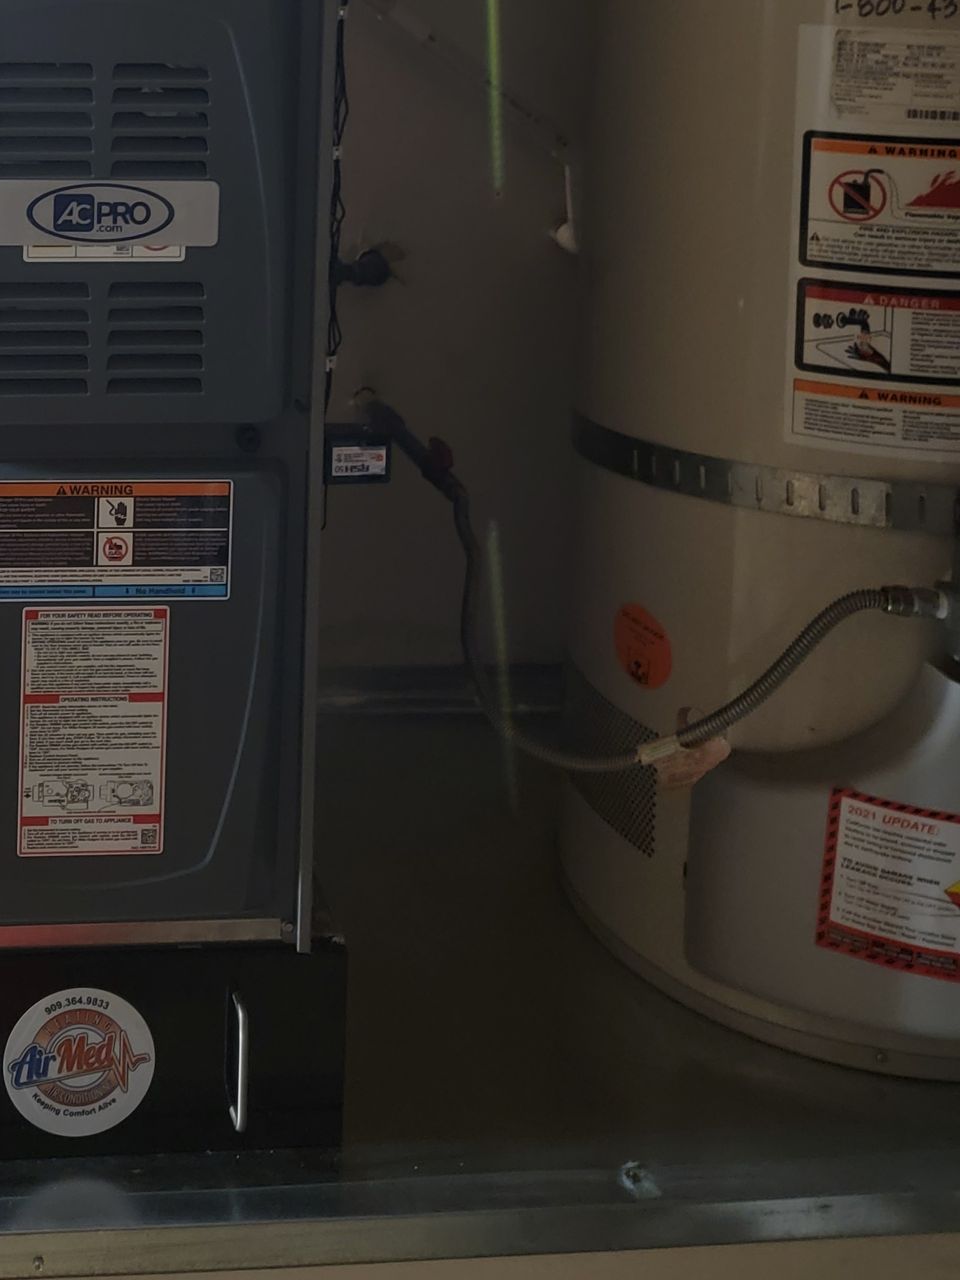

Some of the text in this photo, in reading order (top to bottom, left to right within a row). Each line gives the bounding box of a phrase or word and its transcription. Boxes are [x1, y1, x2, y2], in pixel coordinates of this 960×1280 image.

[885, 145, 958, 158] WARNING
[96, 225, 123, 233] .com
[879, 294, 941, 309] DANGER
[877, 392, 942, 406] WARNING
[69, 485, 134, 496] WARNING
[135, 587, 186, 595] No Handhold
[847, 804, 876, 819] 2021
[44, 996, 110, 1016] 909.364.9833
[31, 1092, 118, 1118] Keeping Comfort Alive
